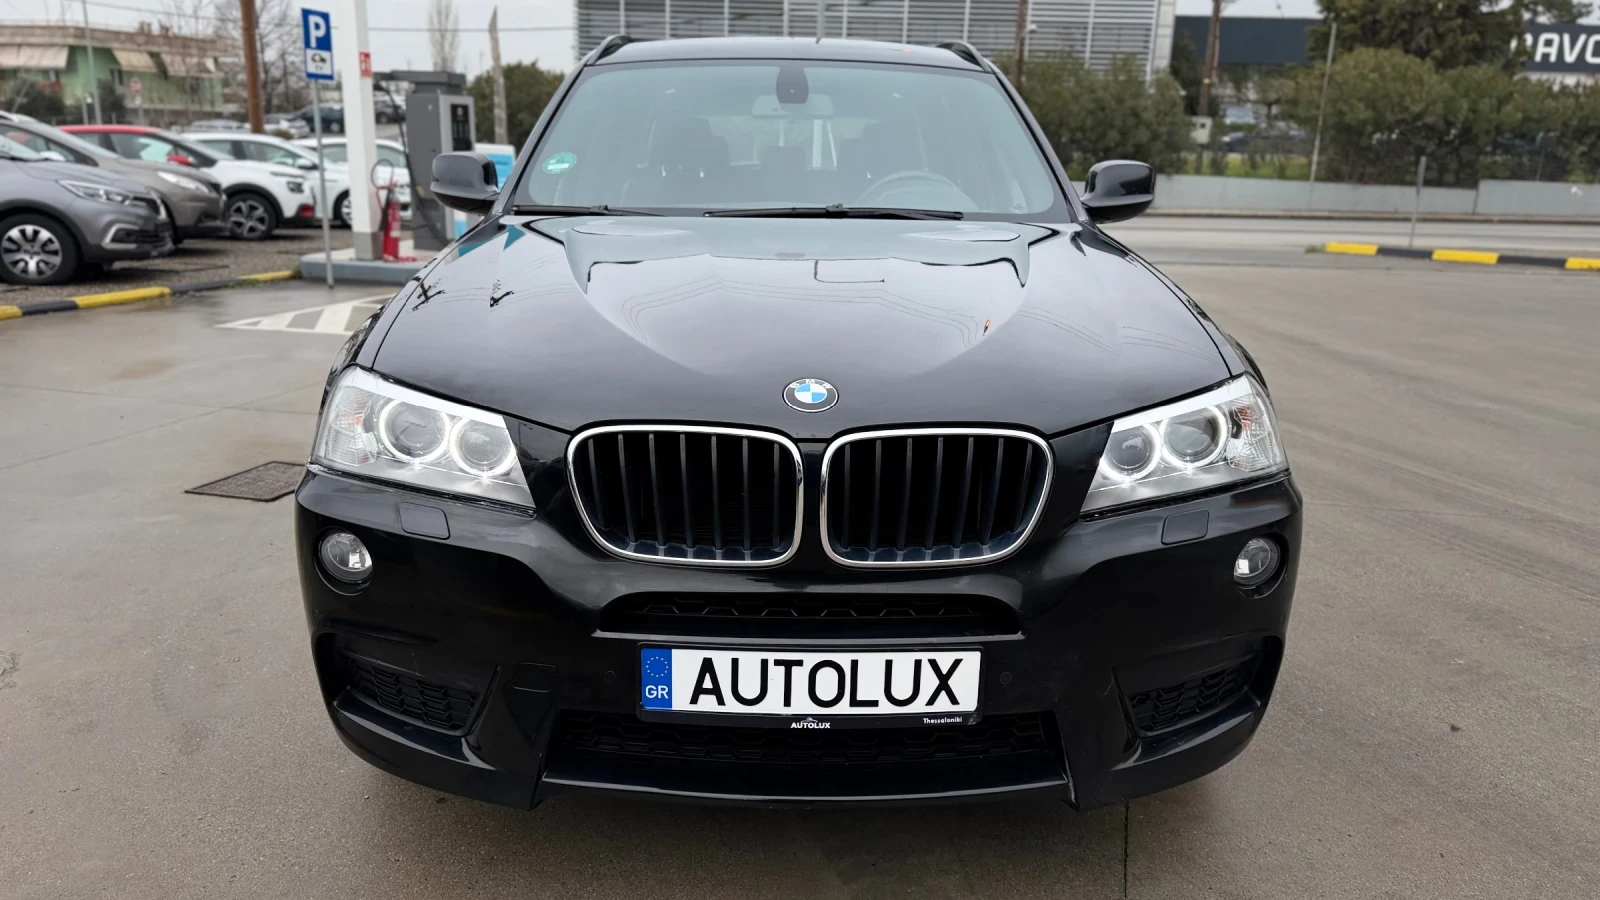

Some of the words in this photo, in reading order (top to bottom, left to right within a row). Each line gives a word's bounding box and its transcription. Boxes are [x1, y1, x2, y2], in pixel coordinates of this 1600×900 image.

[308, 14, 327, 48] P
[689, 657, 964, 708] AUTOLUX
[645, 685, 669, 699] GR
[790, 721, 831, 729] AUTOLUX
[922, 716, 963, 724] Thessaloniki
